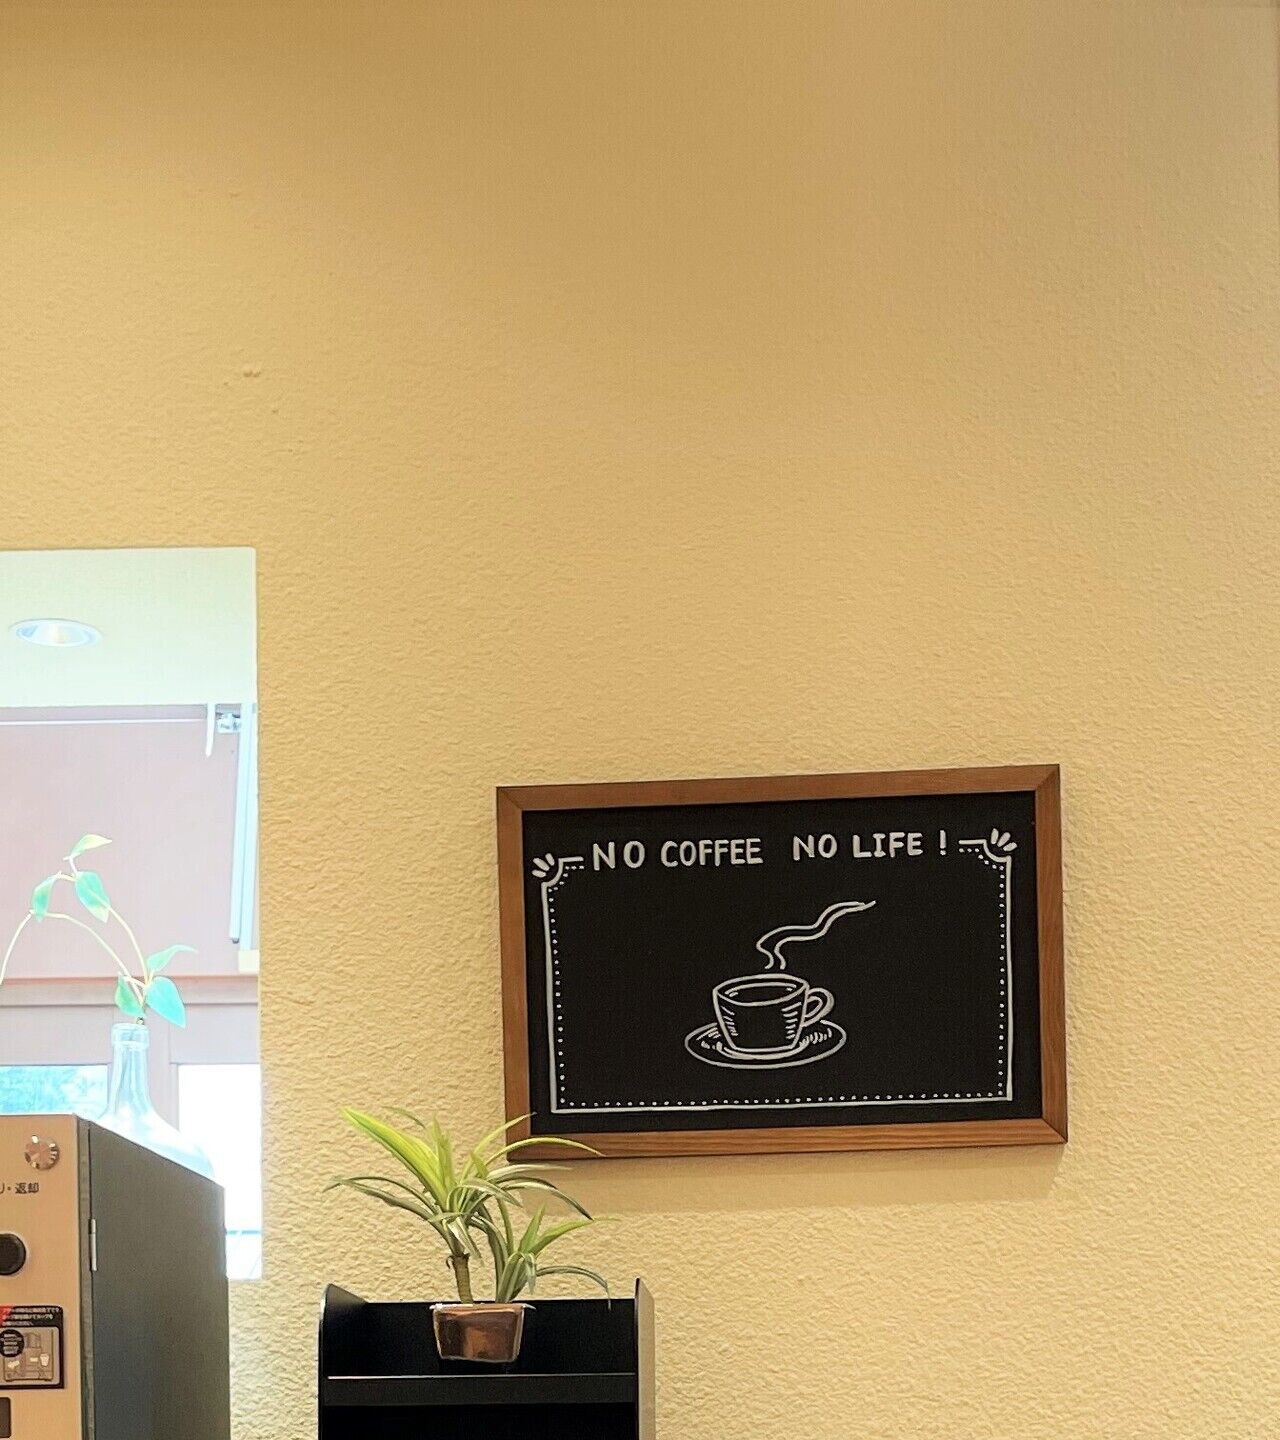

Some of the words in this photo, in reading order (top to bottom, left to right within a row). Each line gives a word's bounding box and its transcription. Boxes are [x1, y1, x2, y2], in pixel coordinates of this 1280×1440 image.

[592, 841, 645, 871] NO
[661, 838, 764, 868] COFFEE
[792, 834, 838, 862] NO
